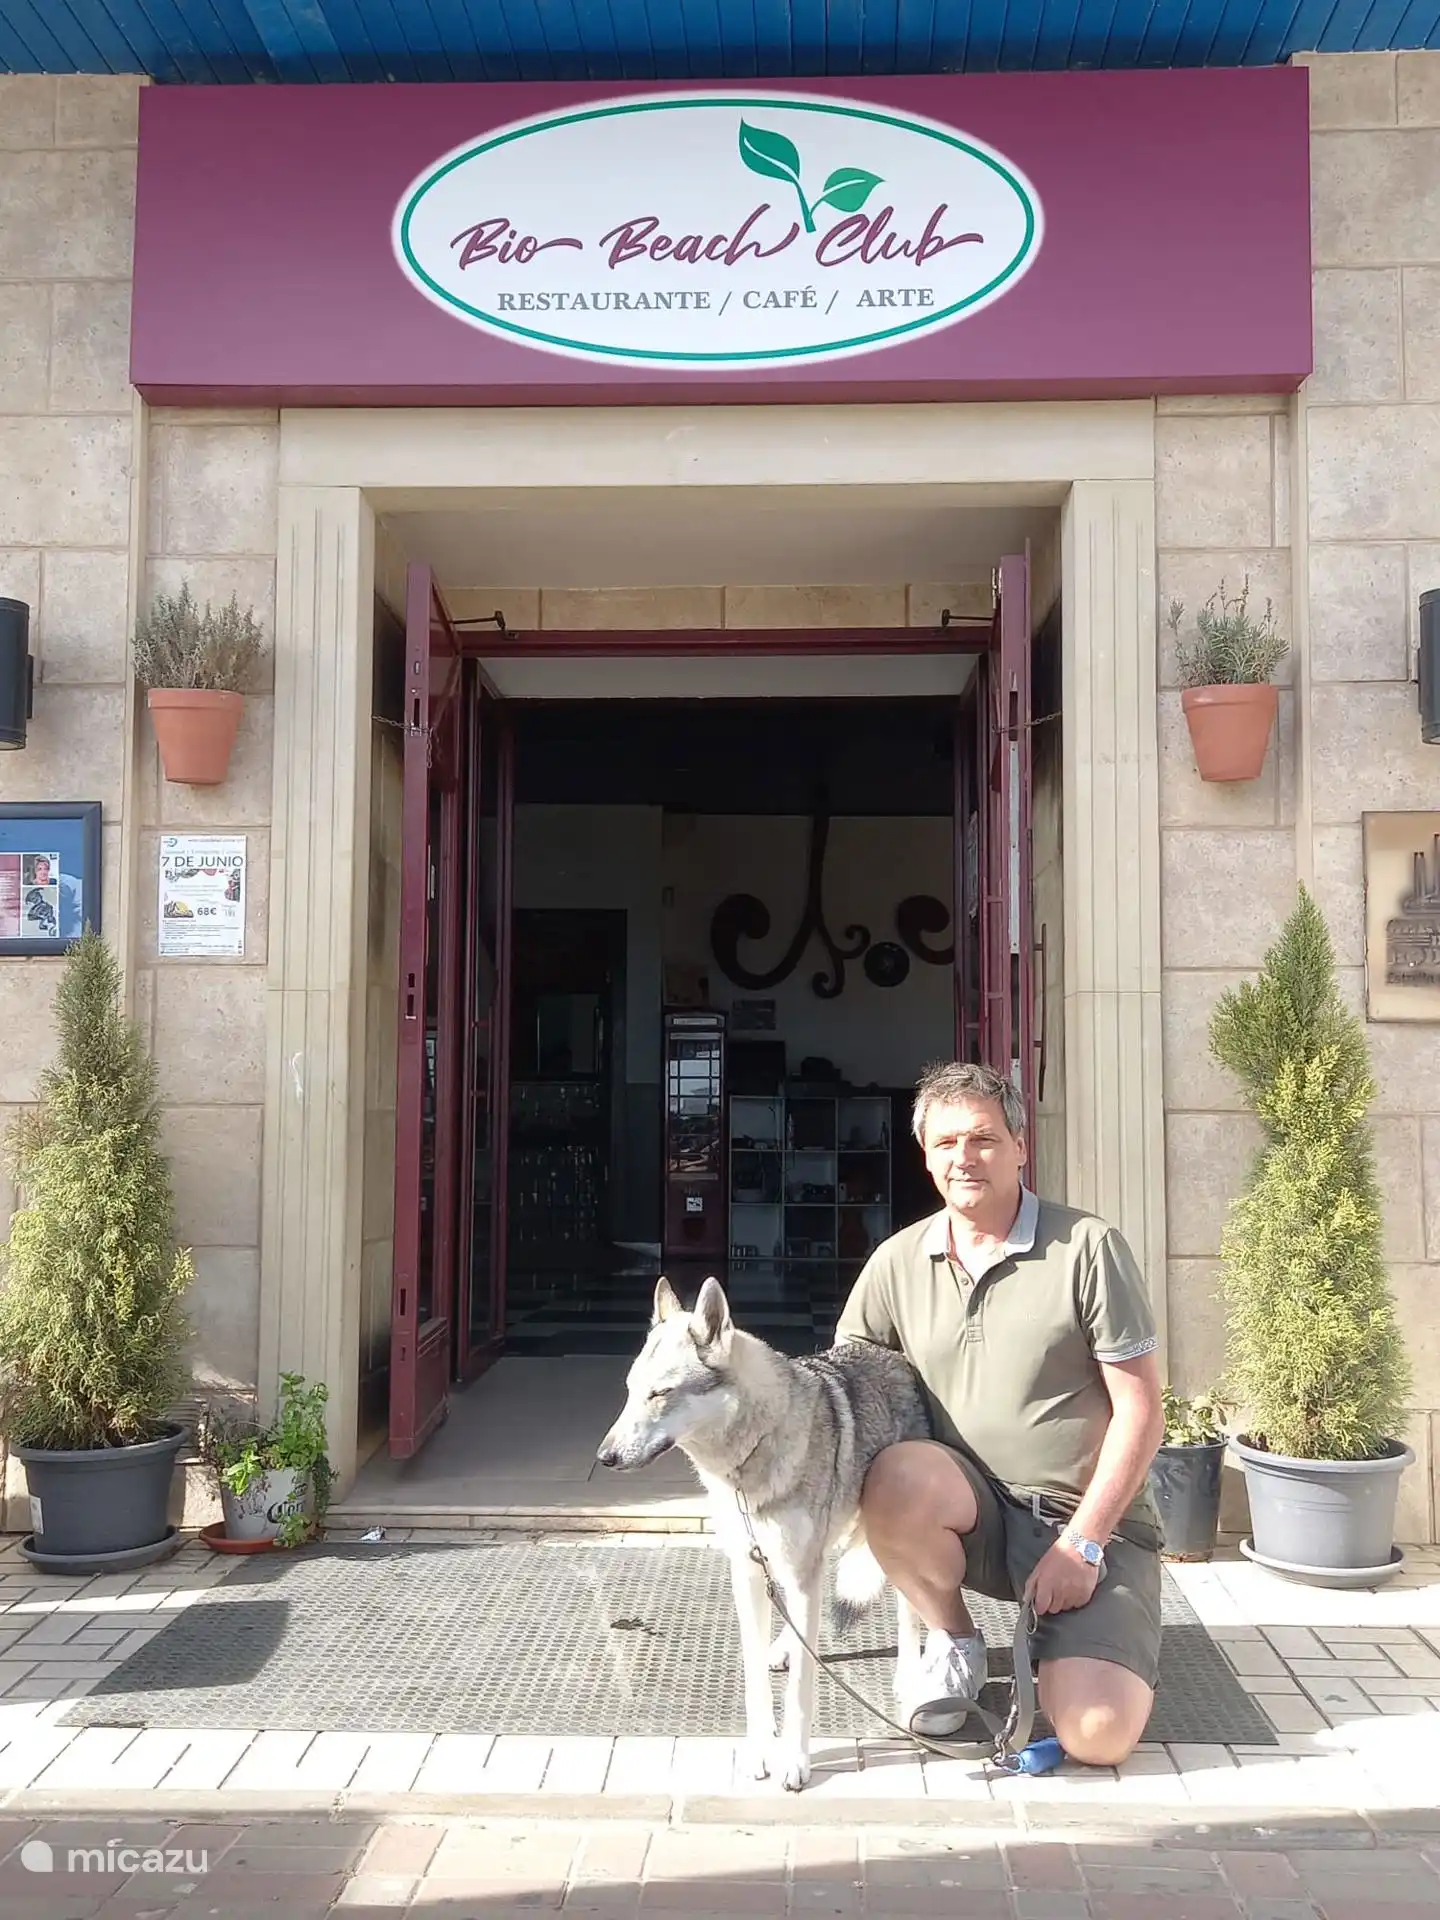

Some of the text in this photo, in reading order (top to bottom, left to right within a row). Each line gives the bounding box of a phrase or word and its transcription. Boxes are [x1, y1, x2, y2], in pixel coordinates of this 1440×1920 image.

[450, 203, 984, 270] Bio Beach Club
[497, 291, 711, 311] RESTAURANTE
[742, 285, 818, 309] CAFÉ
[855, 288, 935, 307] ARTE
[161, 856, 244, 867] 7 DE JUNIO
[197, 907, 217, 916] 68€
